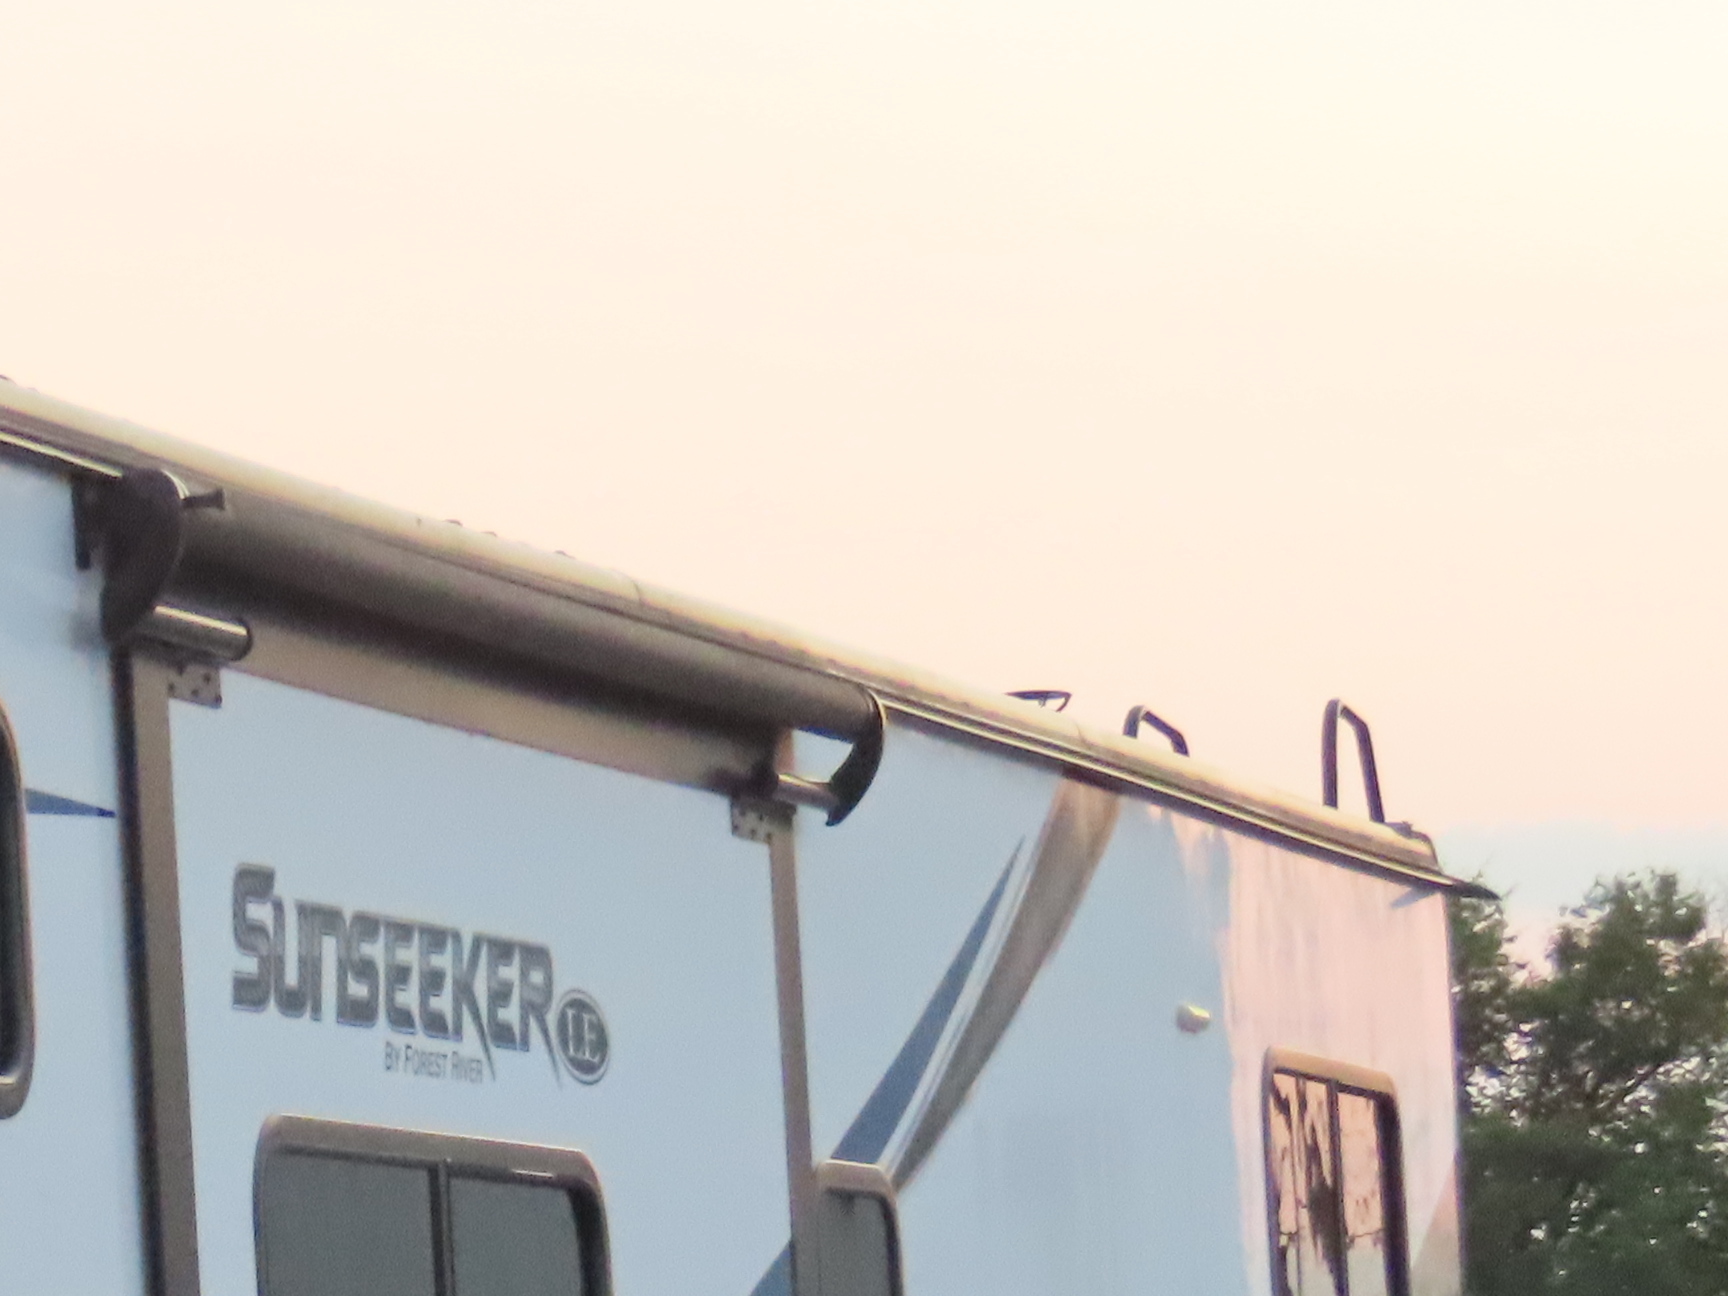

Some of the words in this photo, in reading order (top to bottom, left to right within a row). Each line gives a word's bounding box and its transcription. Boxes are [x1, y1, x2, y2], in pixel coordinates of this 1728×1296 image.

[565, 1008, 601, 1064] LE
[384, 1041, 402, 1073] BY
[403, 1044, 448, 1080] FOREST
[451, 1050, 484, 1084] RIVER
